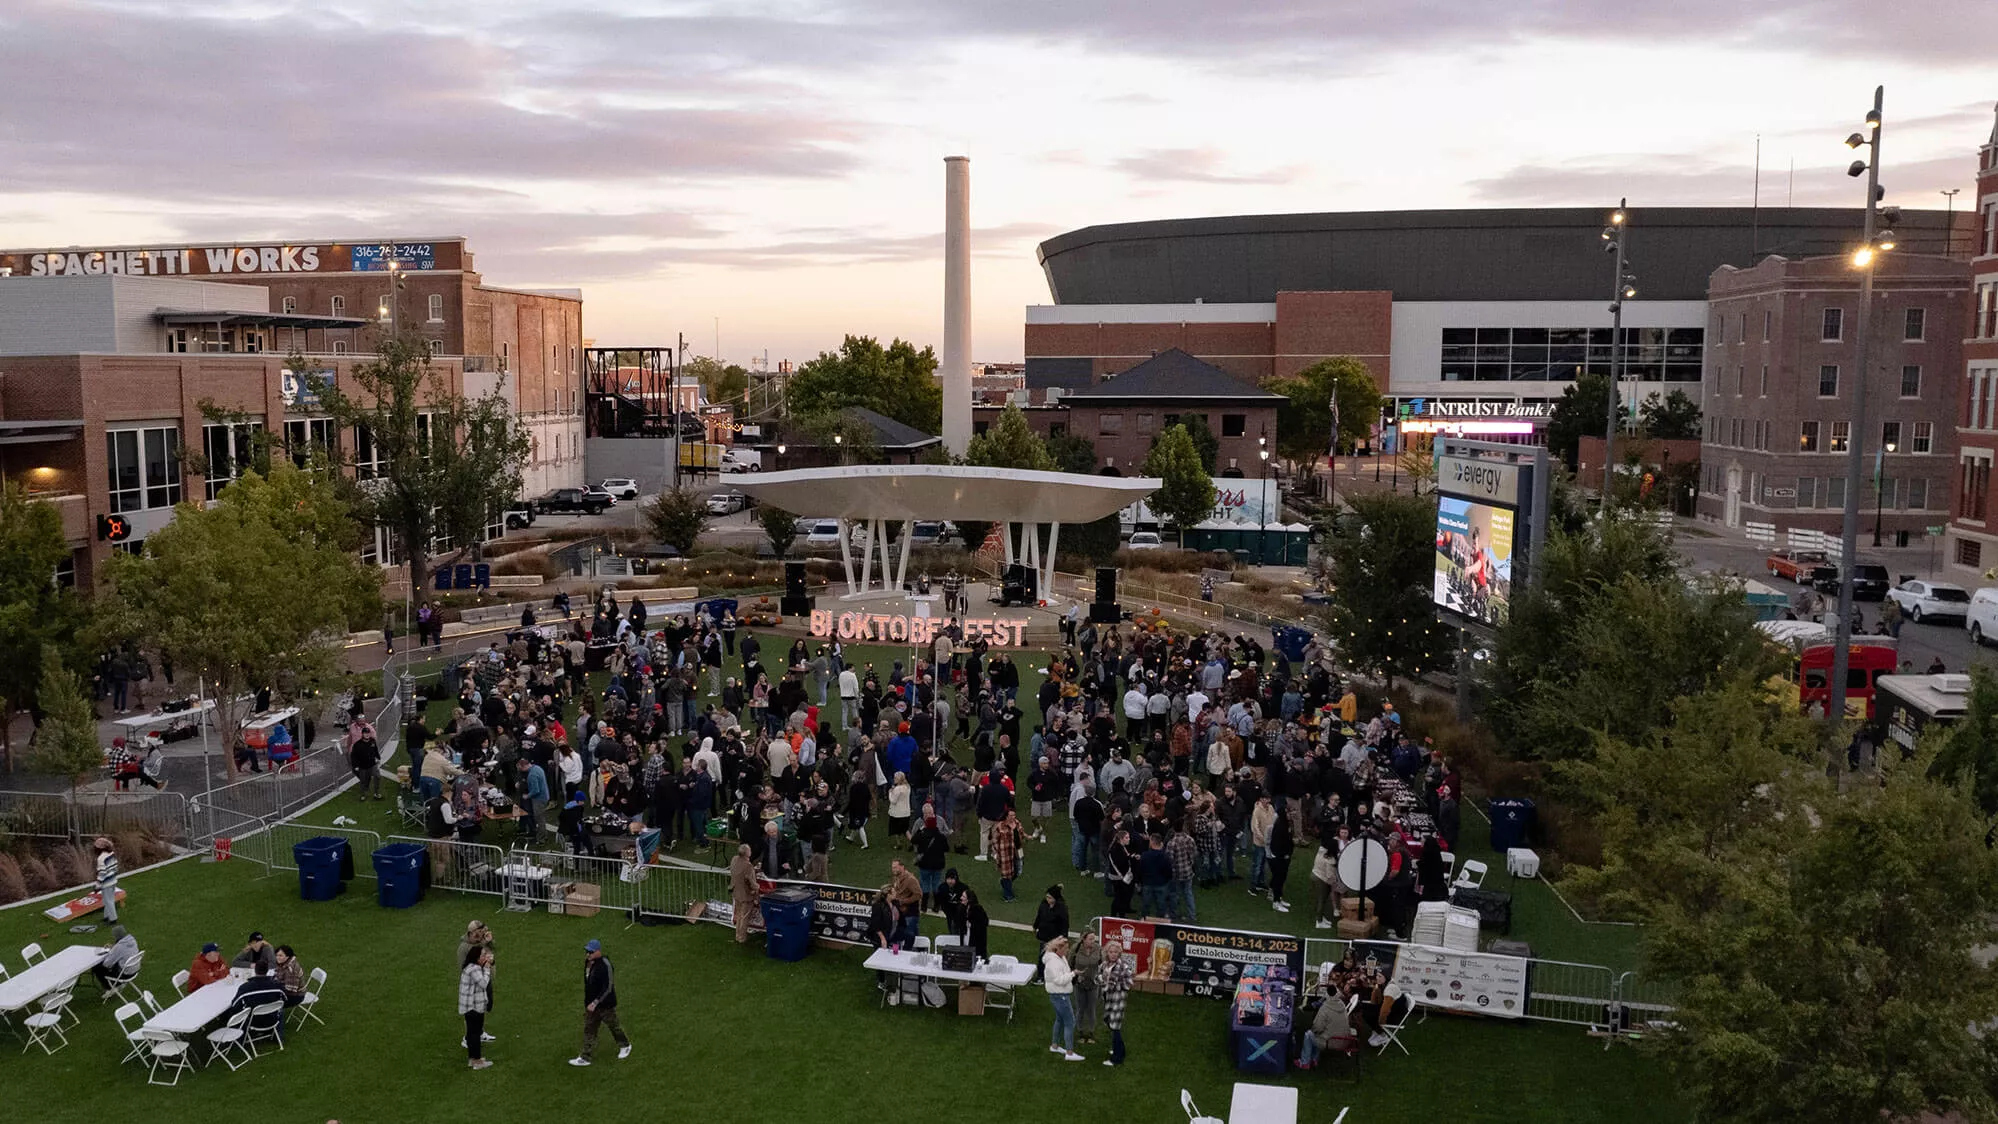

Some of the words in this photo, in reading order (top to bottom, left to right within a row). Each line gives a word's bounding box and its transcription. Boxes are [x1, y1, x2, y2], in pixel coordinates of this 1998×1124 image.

[356, 245, 430, 257] 316-762-2442
[30, 250, 191, 276] SPAGHETTI
[205, 246, 319, 273] WORKS
[1429, 402, 1502, 416] INTRUST
[1504, 403, 1545, 416] Bank
[1464, 464, 1501, 495] evergy
[1176, 930, 1227, 946] October
[1231, 934, 1266, 951] 13-14,
[1269, 938, 1299, 952] 2023
[1188, 946, 1285, 963] ictbloktoberfest.com
